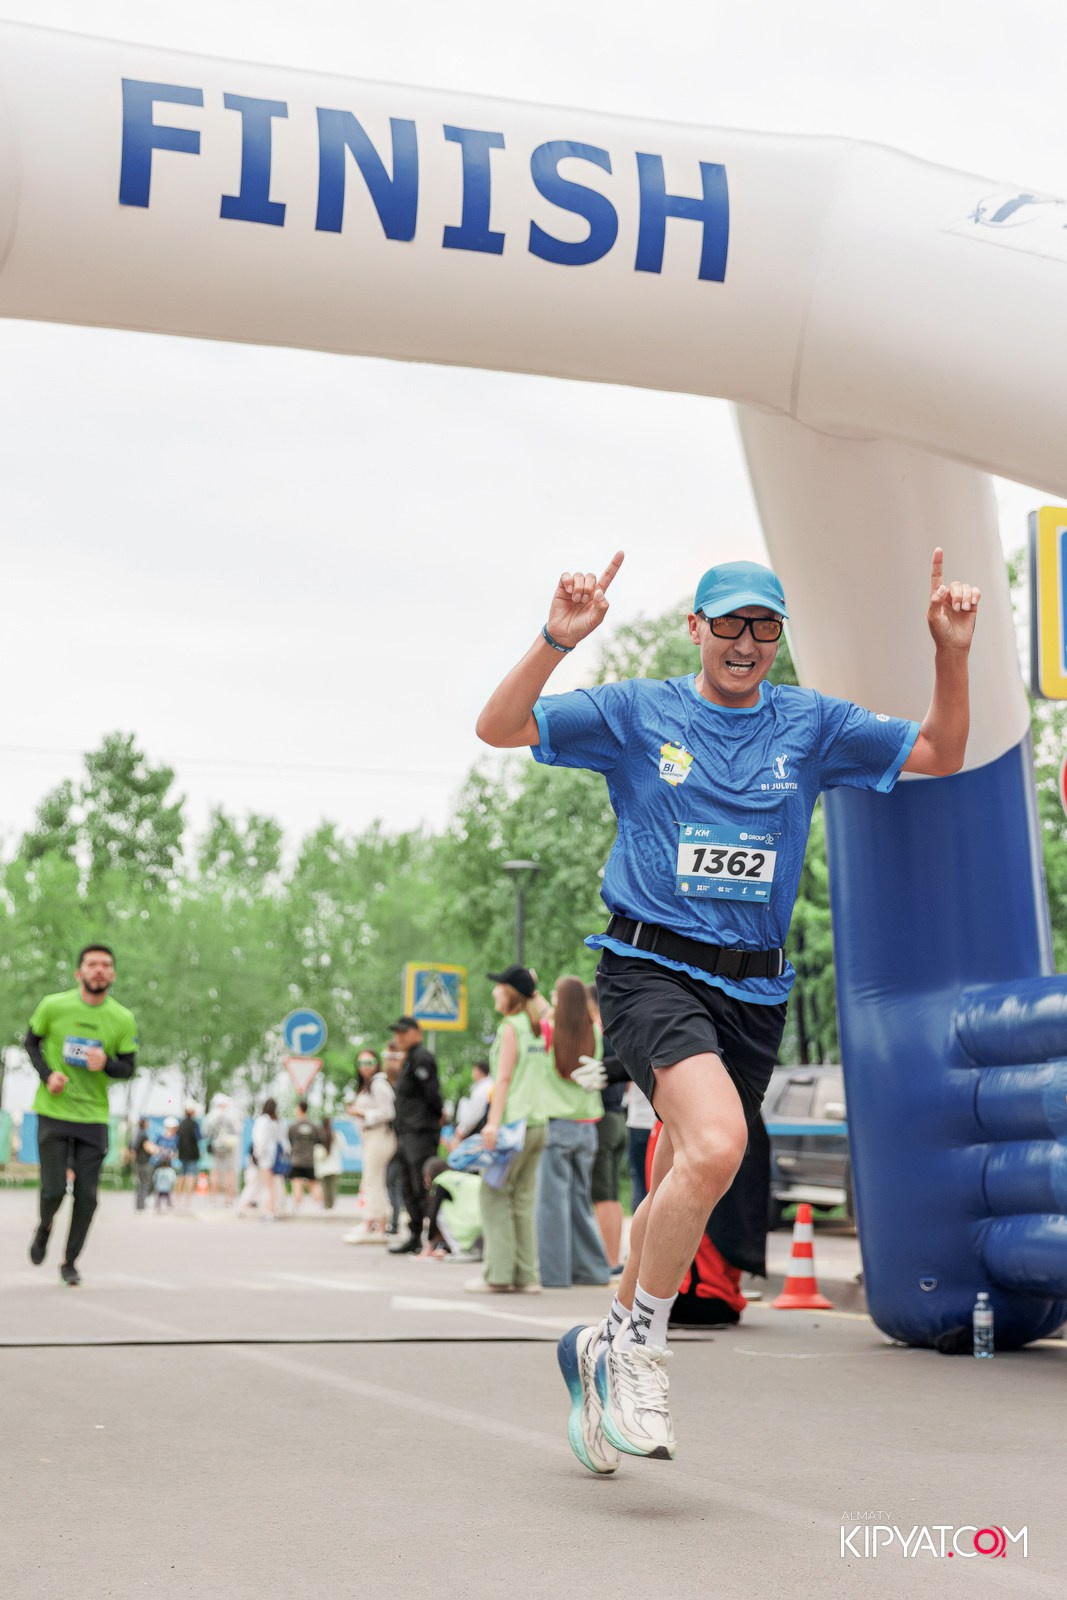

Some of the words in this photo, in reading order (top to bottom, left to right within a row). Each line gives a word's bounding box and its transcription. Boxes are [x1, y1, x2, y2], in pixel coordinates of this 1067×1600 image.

[119, 78, 730, 283] FINISH
[663, 763, 674, 772] BI
[685, 827, 693, 836] 5
[694, 829, 710, 837] KM
[747, 834, 765, 842] GROUP
[692, 848, 765, 878] 1362
